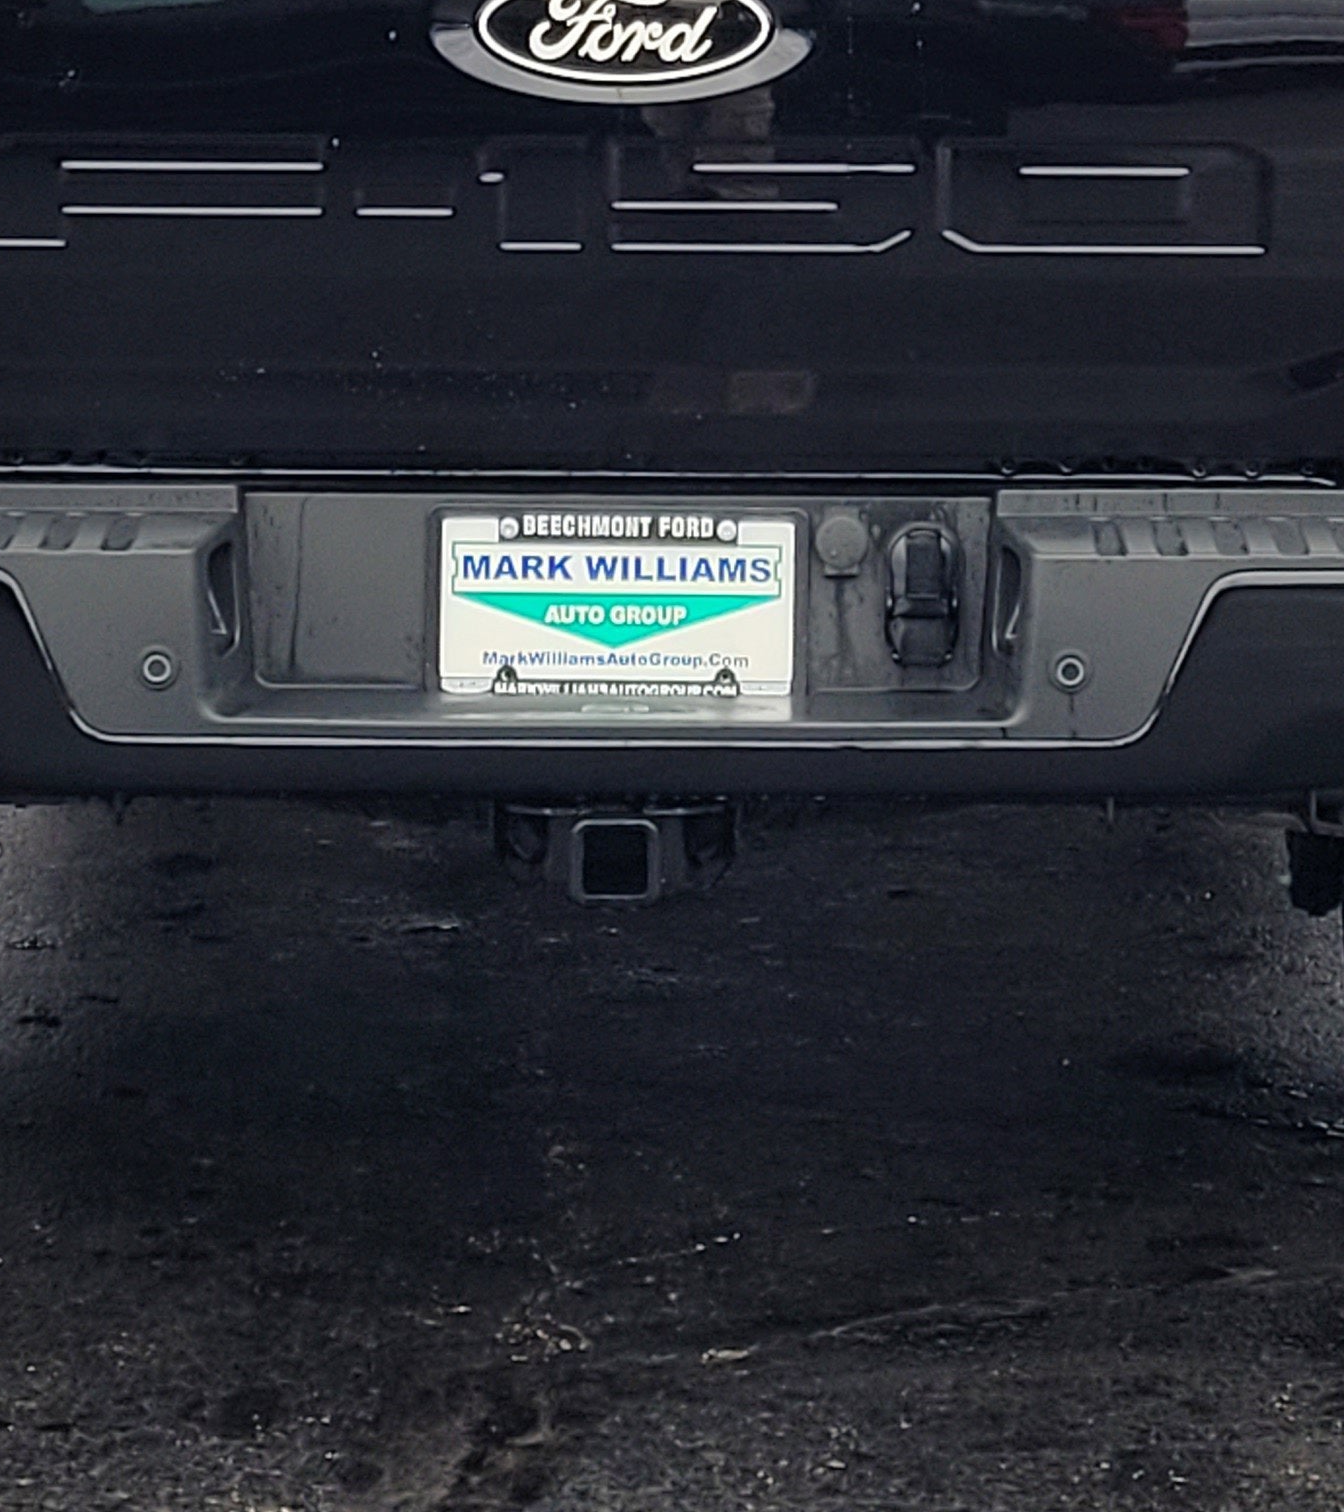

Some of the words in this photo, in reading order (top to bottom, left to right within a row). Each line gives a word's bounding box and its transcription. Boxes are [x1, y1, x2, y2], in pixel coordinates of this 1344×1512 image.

[522, 514, 653, 537] BEECHMONT
[658, 516, 714, 538] FORD
[462, 554, 574, 581] MARK
[585, 555, 772, 583] WILLIAMS
[544, 606, 604, 625] AUTO
[609, 605, 688, 625] GROUP
[482, 651, 750, 669] MarkWilliamsAutoGroup.Com
